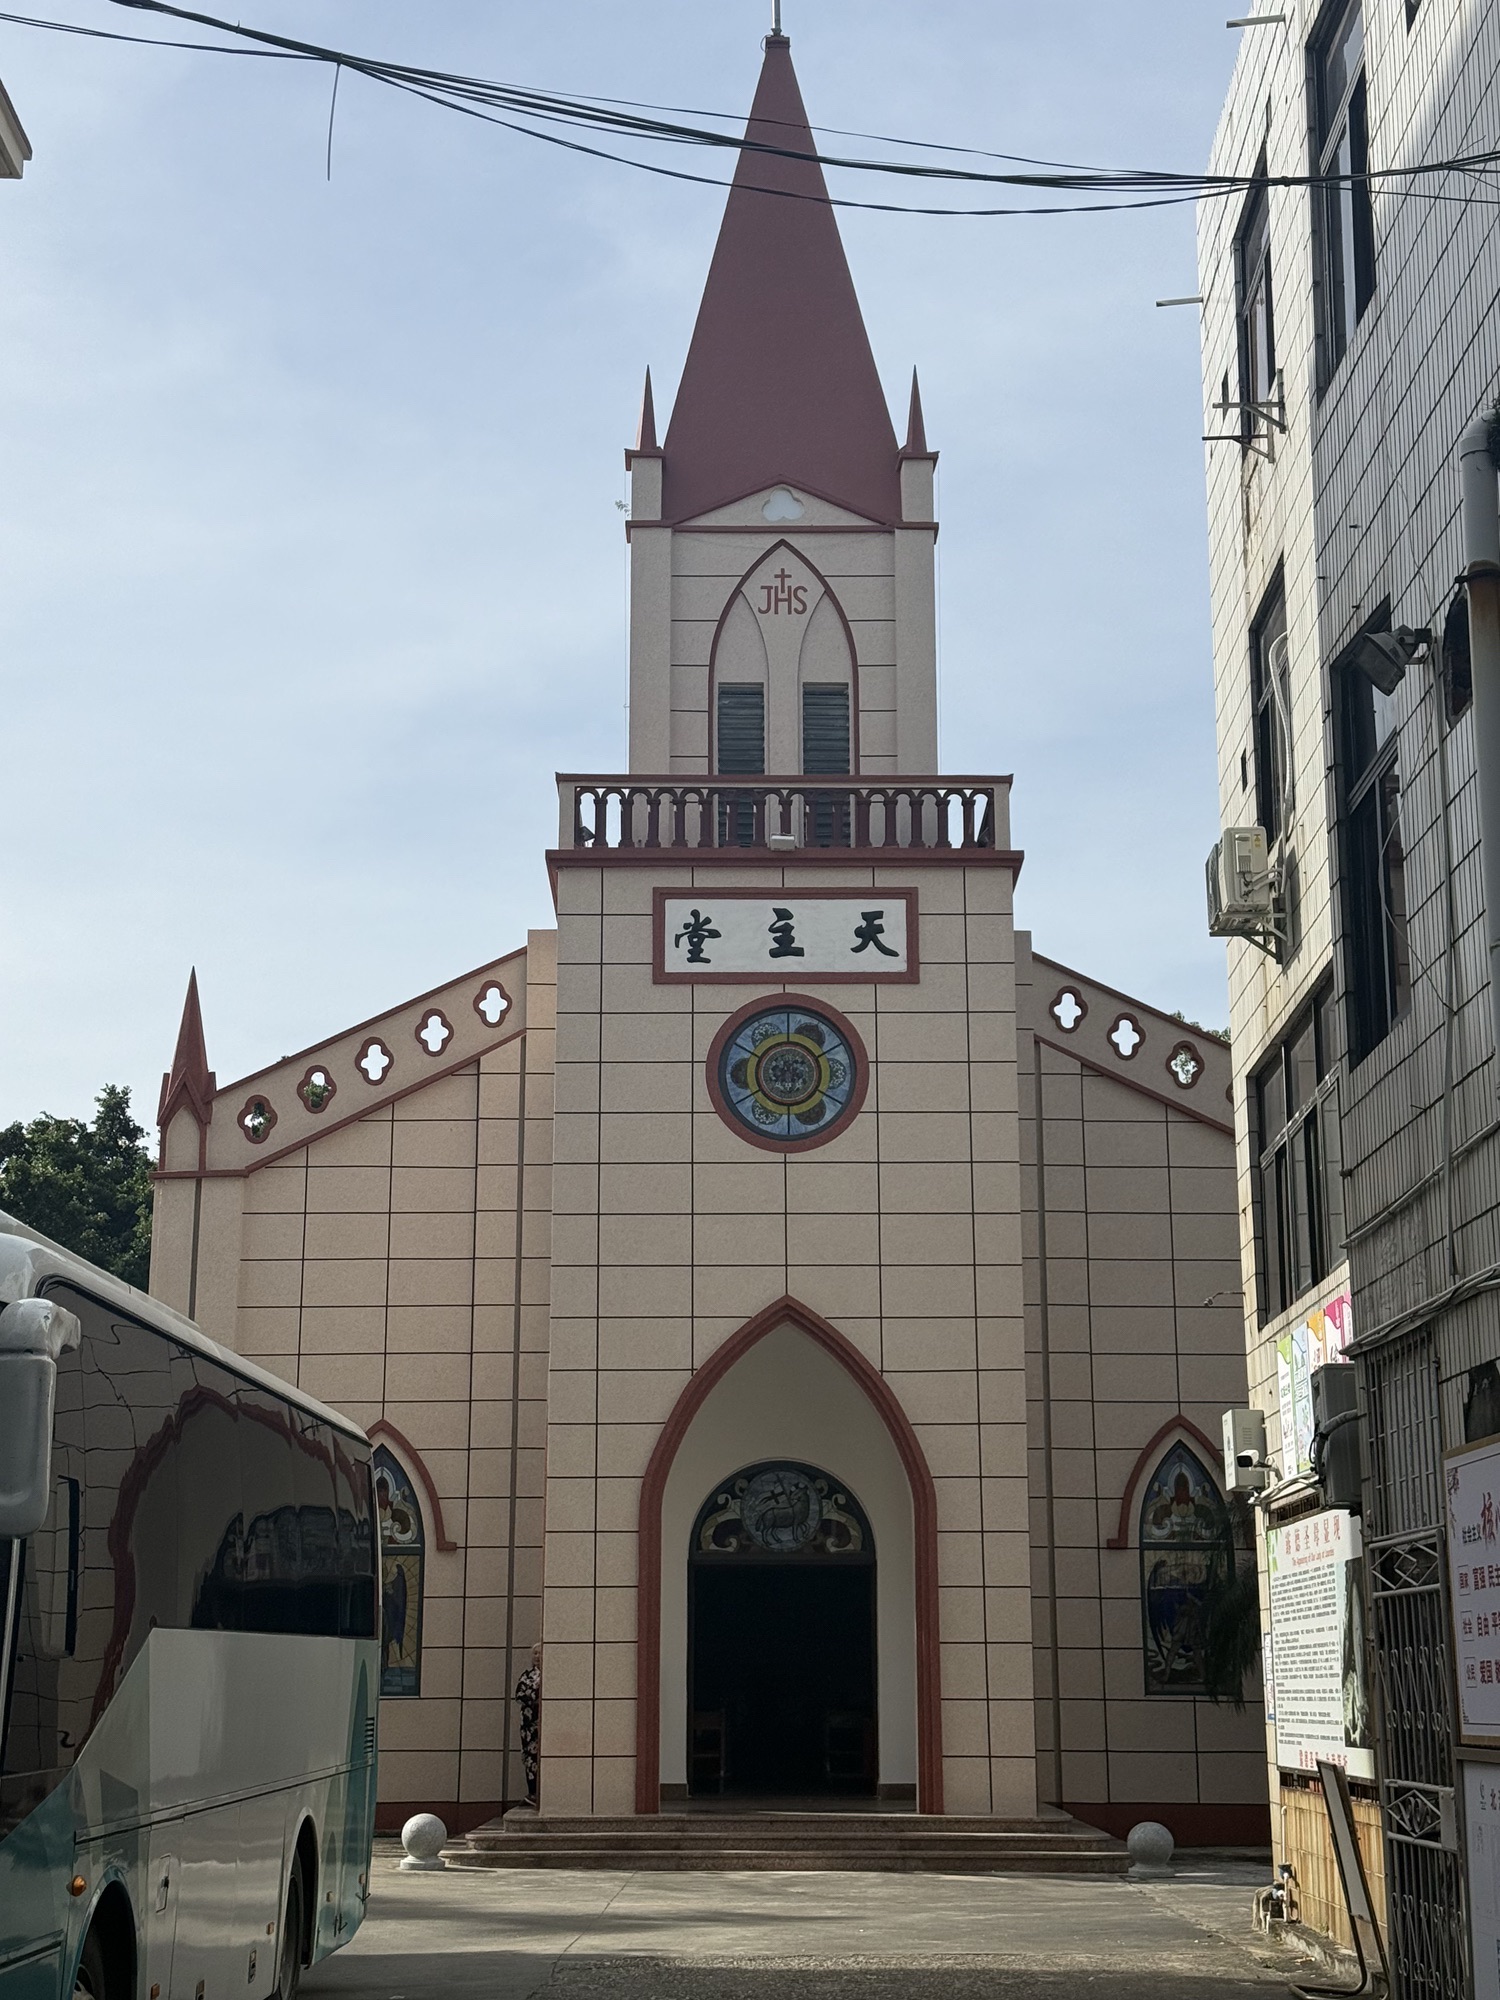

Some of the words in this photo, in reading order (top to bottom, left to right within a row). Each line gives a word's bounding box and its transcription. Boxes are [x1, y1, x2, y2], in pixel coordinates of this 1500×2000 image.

[758, 585, 808, 615] JHS
[674, 908, 900, 963] 天主堂
[1473, 1567, 1486, 1591] 富强
[1477, 1613, 1489, 1638] 自由
[1480, 1660, 1493, 1684] 爱国
